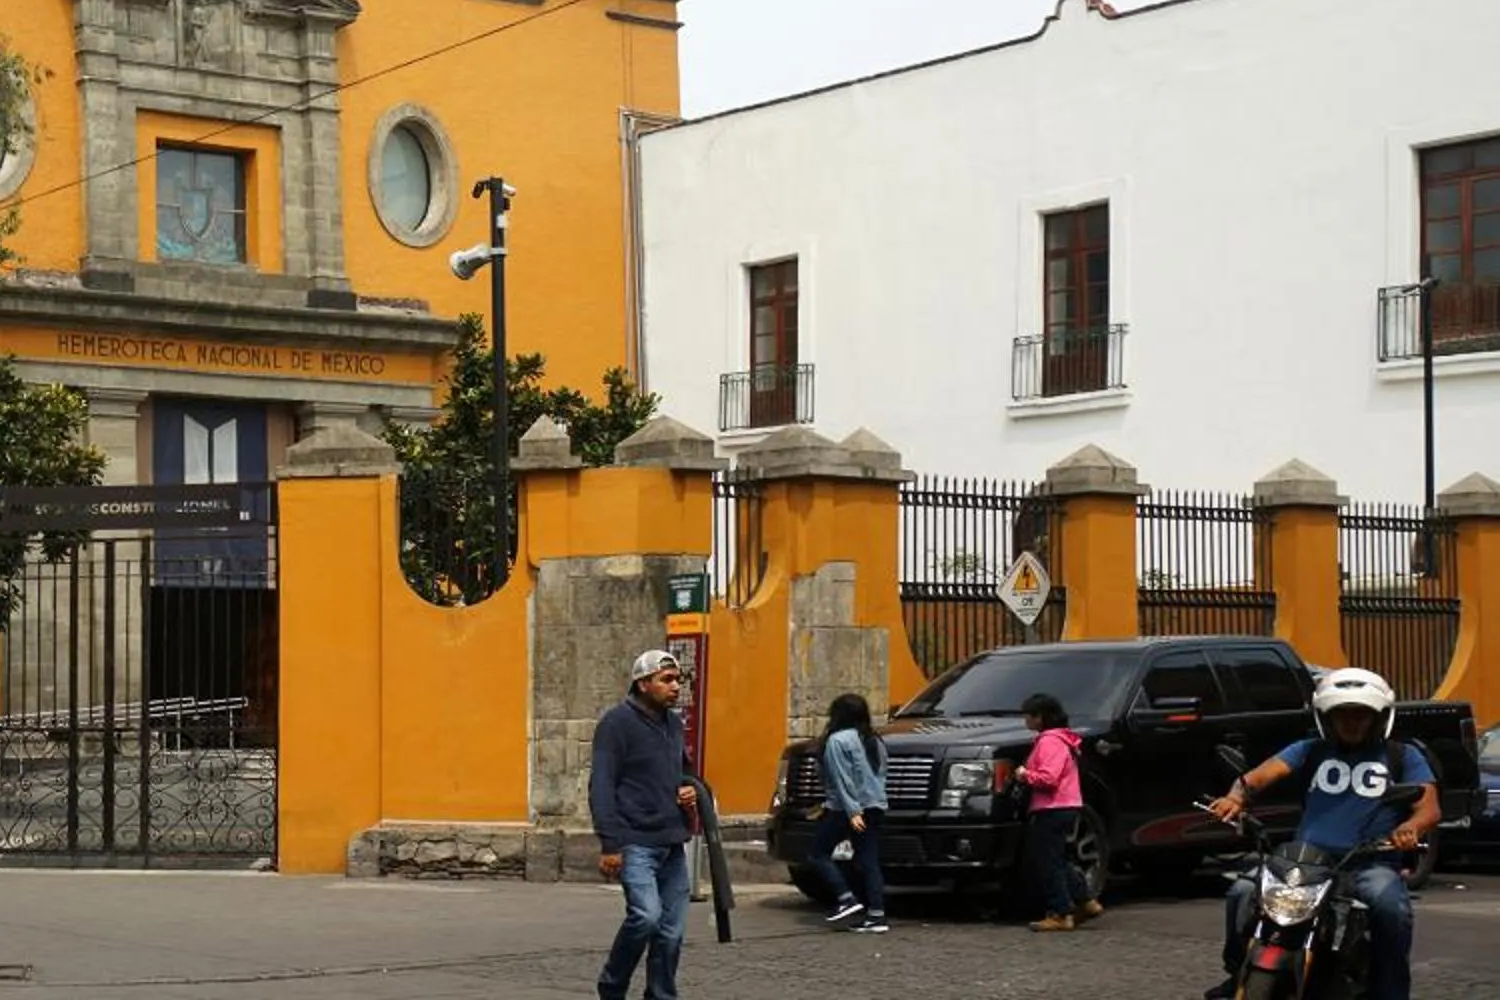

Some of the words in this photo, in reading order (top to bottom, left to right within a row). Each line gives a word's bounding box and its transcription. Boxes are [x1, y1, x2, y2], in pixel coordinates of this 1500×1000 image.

[57, 333, 186, 362] HEMEROTECA
[197, 343, 282, 369] NACIONAL
[291, 351, 311, 371] DE
[321, 352, 385, 374] MEXICO
[1309, 758, 1389, 797] OG
